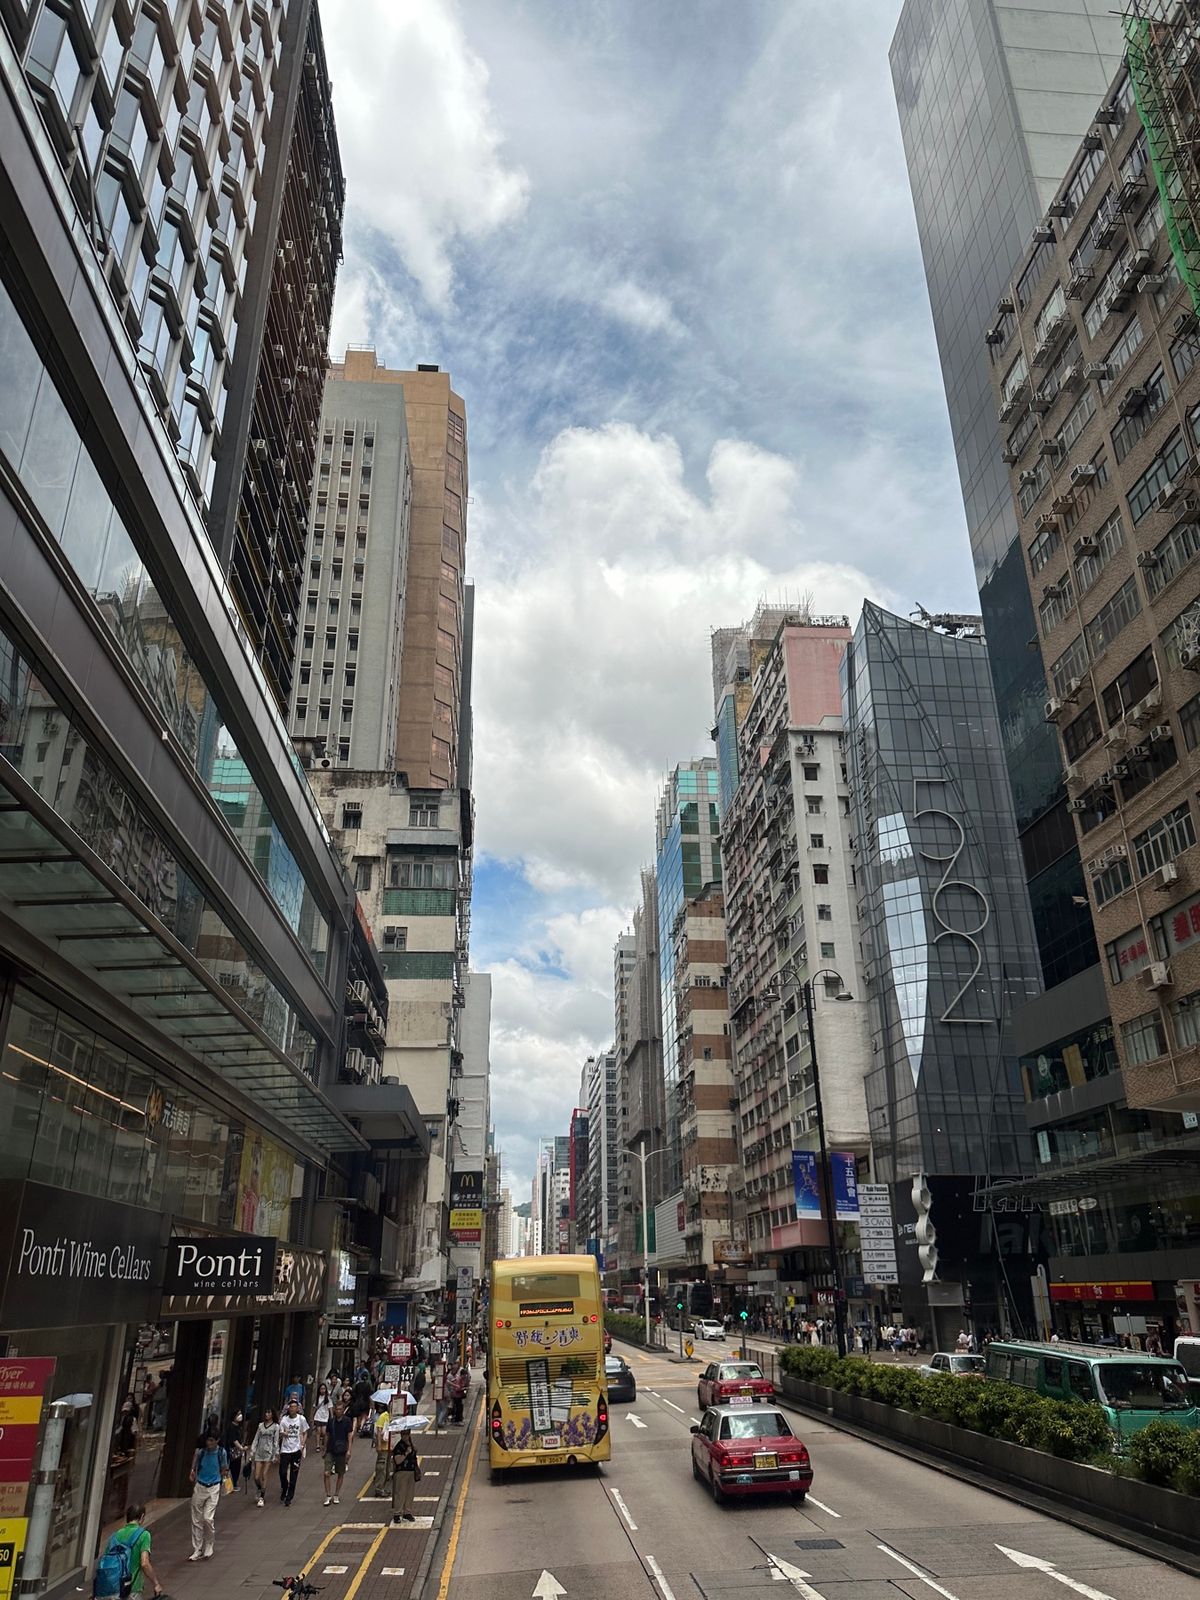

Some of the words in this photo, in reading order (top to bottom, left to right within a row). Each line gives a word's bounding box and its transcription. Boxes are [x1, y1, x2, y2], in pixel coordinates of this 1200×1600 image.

[844, 1157, 856, 1198] 十五運會
[870, 1217, 891, 1226] OWN
[18, 1228, 68, 1275] Ponti
[69, 1241, 107, 1278] Wine
[109, 1245, 151, 1280] Cellars
[177, 1245, 262, 1277] Ponti
[194, 1280, 216, 1288] wine
[221, 1279, 259, 1288] cellars
[329, 1329, 358, 1340] 遊戲機
